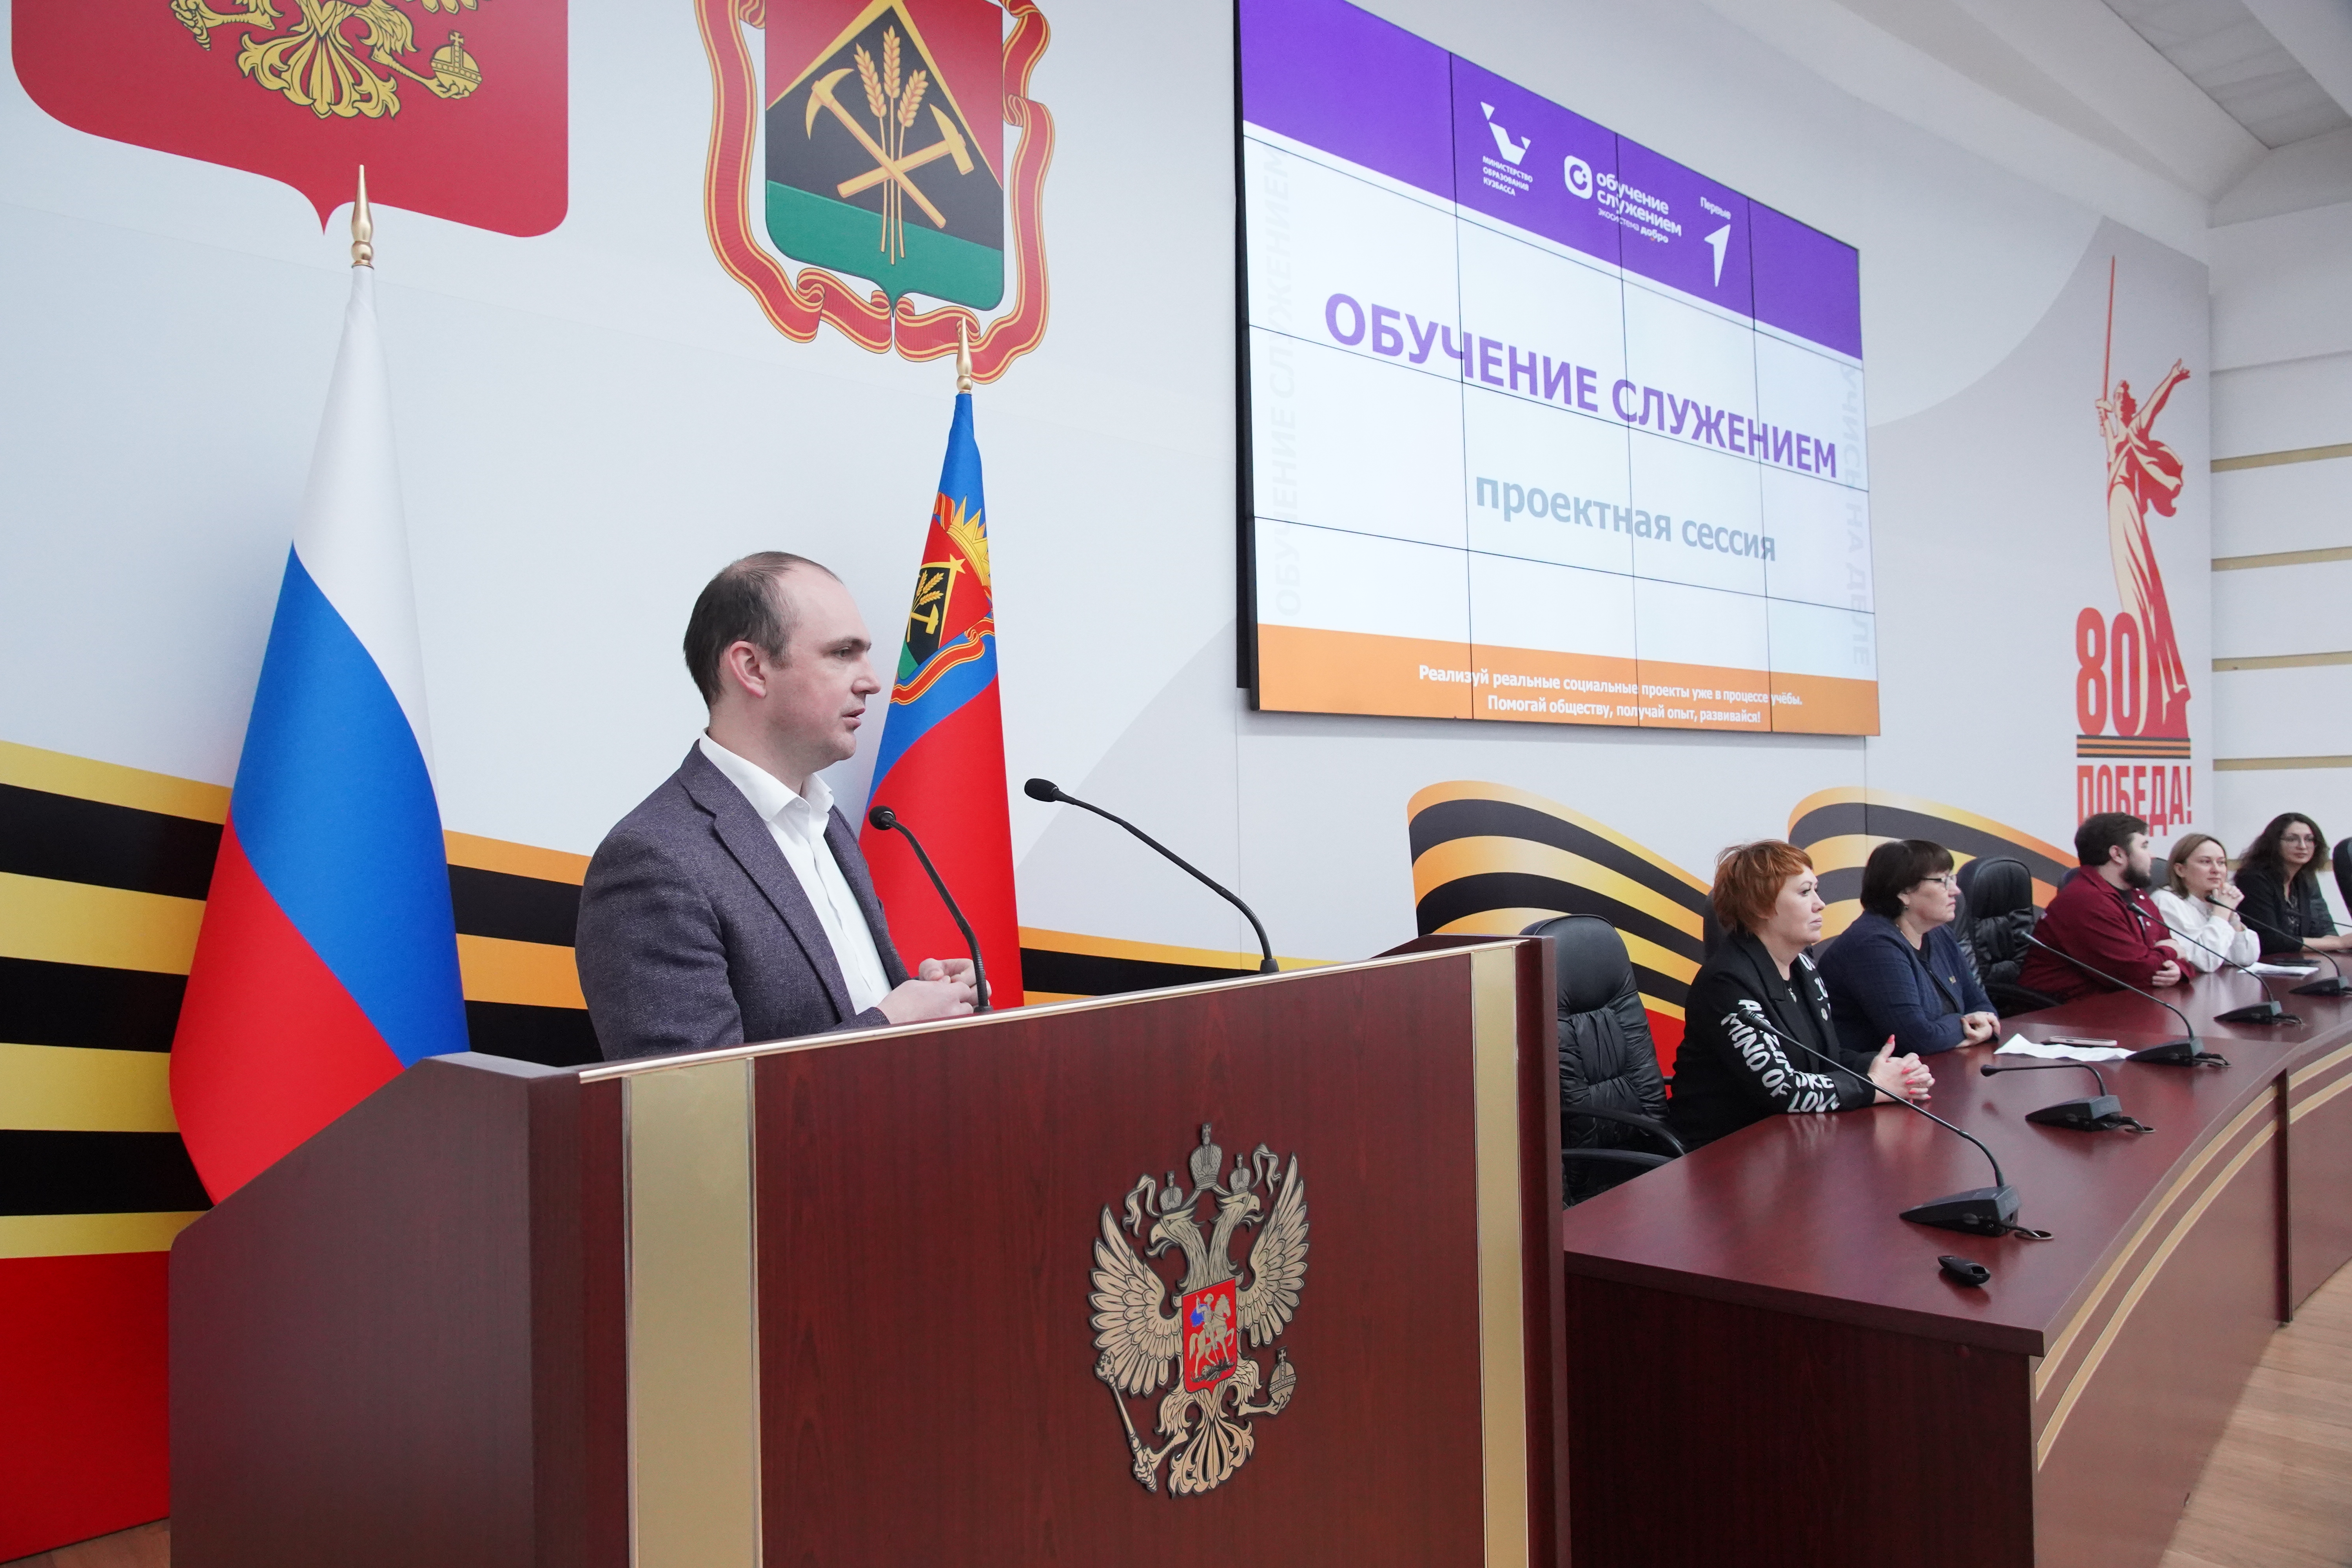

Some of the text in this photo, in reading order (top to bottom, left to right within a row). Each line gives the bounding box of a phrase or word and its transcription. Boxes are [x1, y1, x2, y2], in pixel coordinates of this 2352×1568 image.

[1483, 156, 1533, 183] МИНИСТЕРСТВО
[1483, 167, 1529, 191] ОБРАЗОВАНИЯ
[1483, 177, 1515, 196] КУЗБАССА
[1597, 173, 1669, 214] обучение
[1597, 190, 1682, 236] служением
[1325, 293, 1836, 478] ОБУЧЕНИЕ СЛУЖЕНИЕМ
[1476, 477, 1776, 562] проектная сессия
[1419, 665, 1489, 687] Реализуй
[1493, 673, 1561, 689] реальные
[1563, 678, 1638, 693] социальные
[1642, 684, 1689, 699] проекты
[1692, 688, 1713, 701] уже
[1715, 690, 1721, 700] в
[1723, 690, 1768, 703] процессе
[2076, 607, 2140, 736] 80
[1488, 695, 1761, 723] Помогай обществу, получай опыт, развивайся!
[2077, 764, 2192, 837] ПОБЕДА!
[1762, 1069, 1792, 1097] OF
